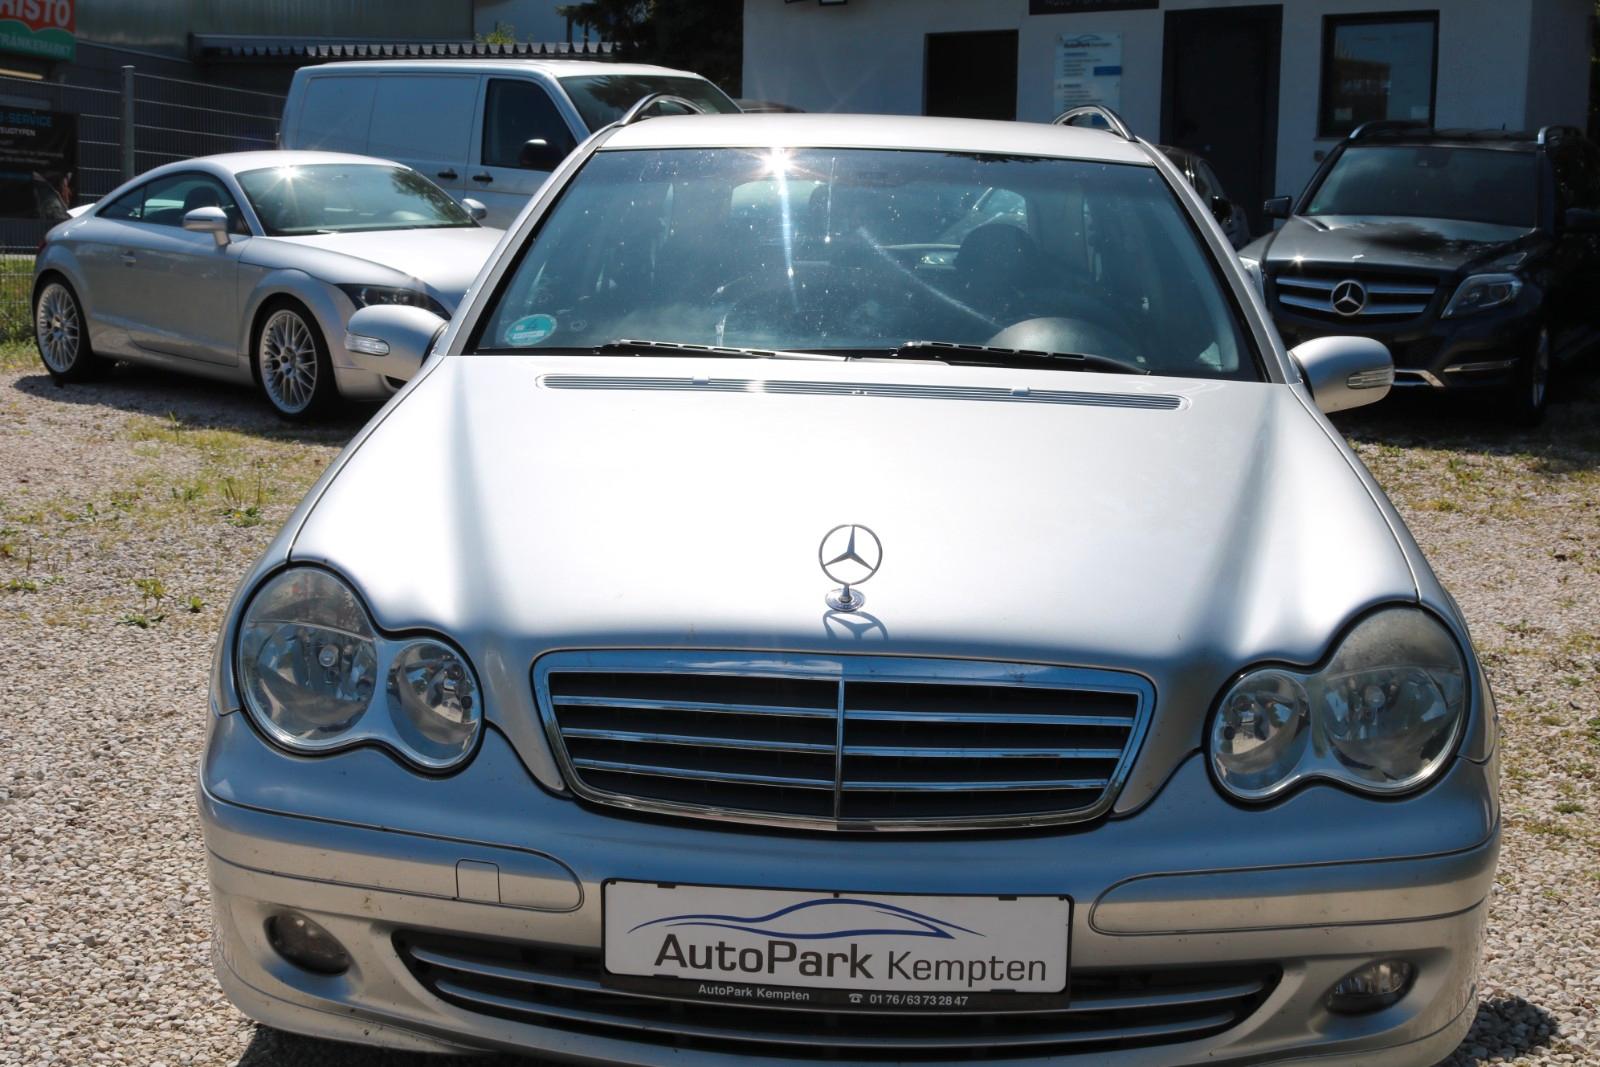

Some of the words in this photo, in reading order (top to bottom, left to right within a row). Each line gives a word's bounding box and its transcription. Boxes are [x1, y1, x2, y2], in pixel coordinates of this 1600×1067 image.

[654, 933, 874, 979] AutoPark
[887, 950, 1047, 988] Kempten
[698, 984, 753, 998] AutoPark
[756, 987, 810, 1001] Kempten
